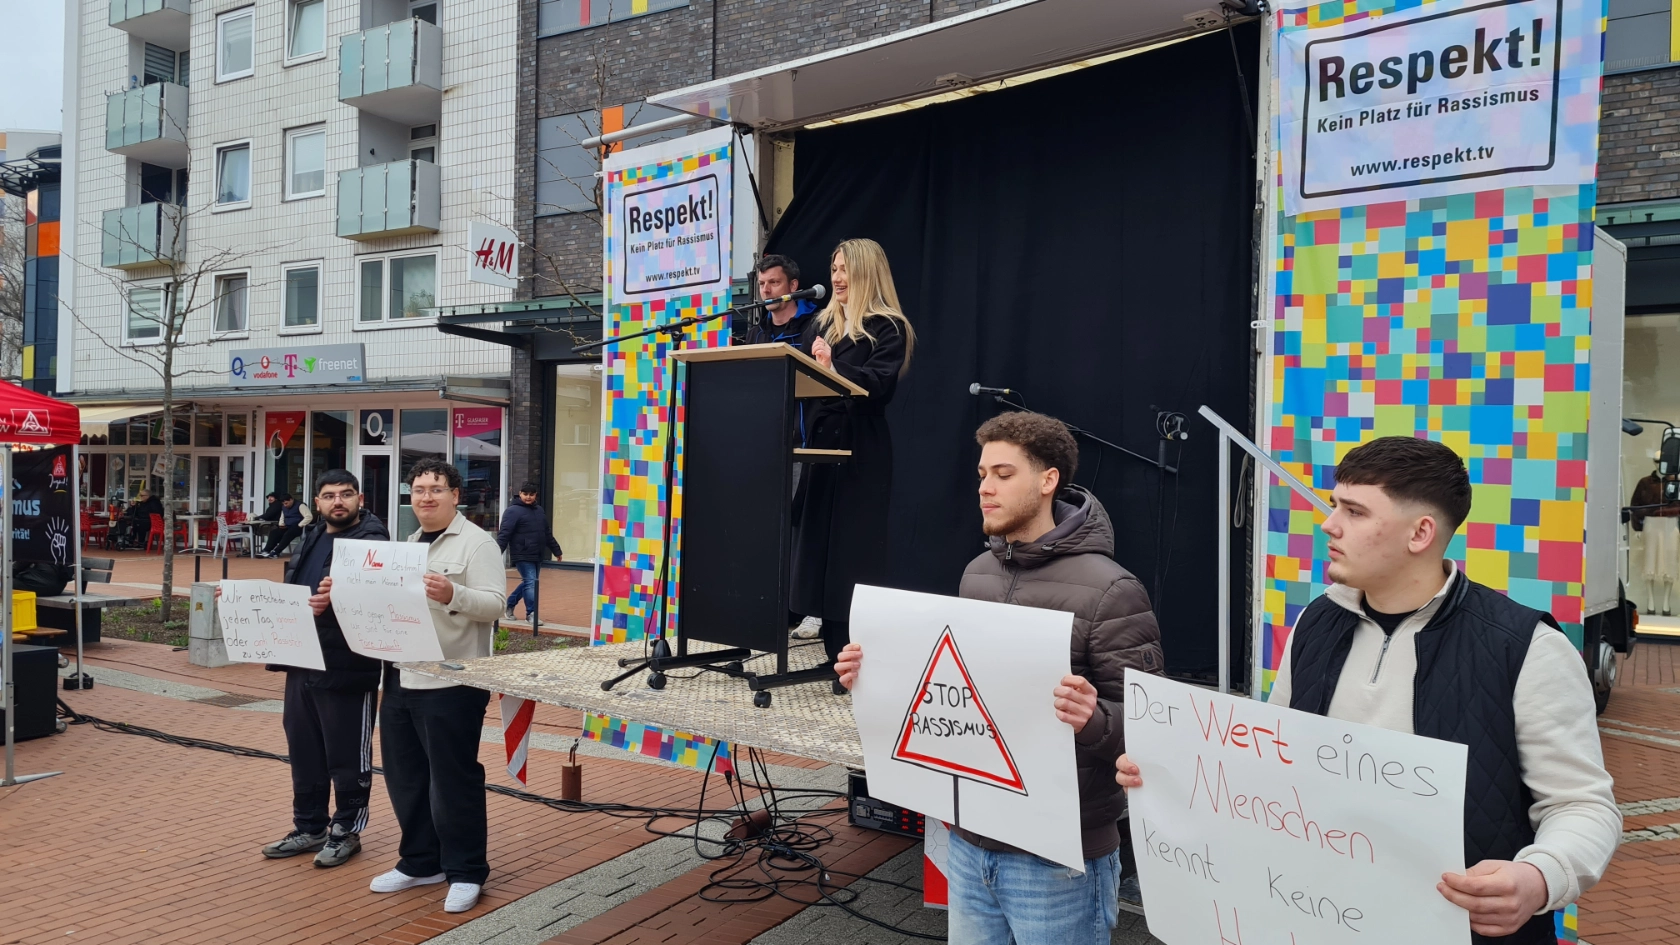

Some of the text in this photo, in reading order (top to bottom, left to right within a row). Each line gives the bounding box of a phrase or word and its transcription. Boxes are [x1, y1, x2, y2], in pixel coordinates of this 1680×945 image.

[1318, 18, 1543, 102] Respekt!
[1317, 89, 1539, 133] Kein Platz für Rassismus
[1351, 146, 1495, 176] www.respekt.tv
[629, 190, 713, 234] Respekt!
[475, 237, 514, 274] H&M
[630, 232, 714, 254] Kein Platz für Rassismus
[645, 267, 700, 282] www.respekt.tv
[253, 371, 278, 379] vodafone
[284, 354, 297, 378] T
[319, 358, 358, 371] freenet
[455, 413, 464, 429] T
[221, 584, 242, 604] Wir
[223, 609, 250, 629] jeden
[252, 608, 275, 629] Tag
[922, 682, 974, 709] STOP
[909, 712, 997, 740] RASSISMUS
[1128, 682, 1439, 797] Der Wert eines
[1189, 754, 1374, 864] Menschen
